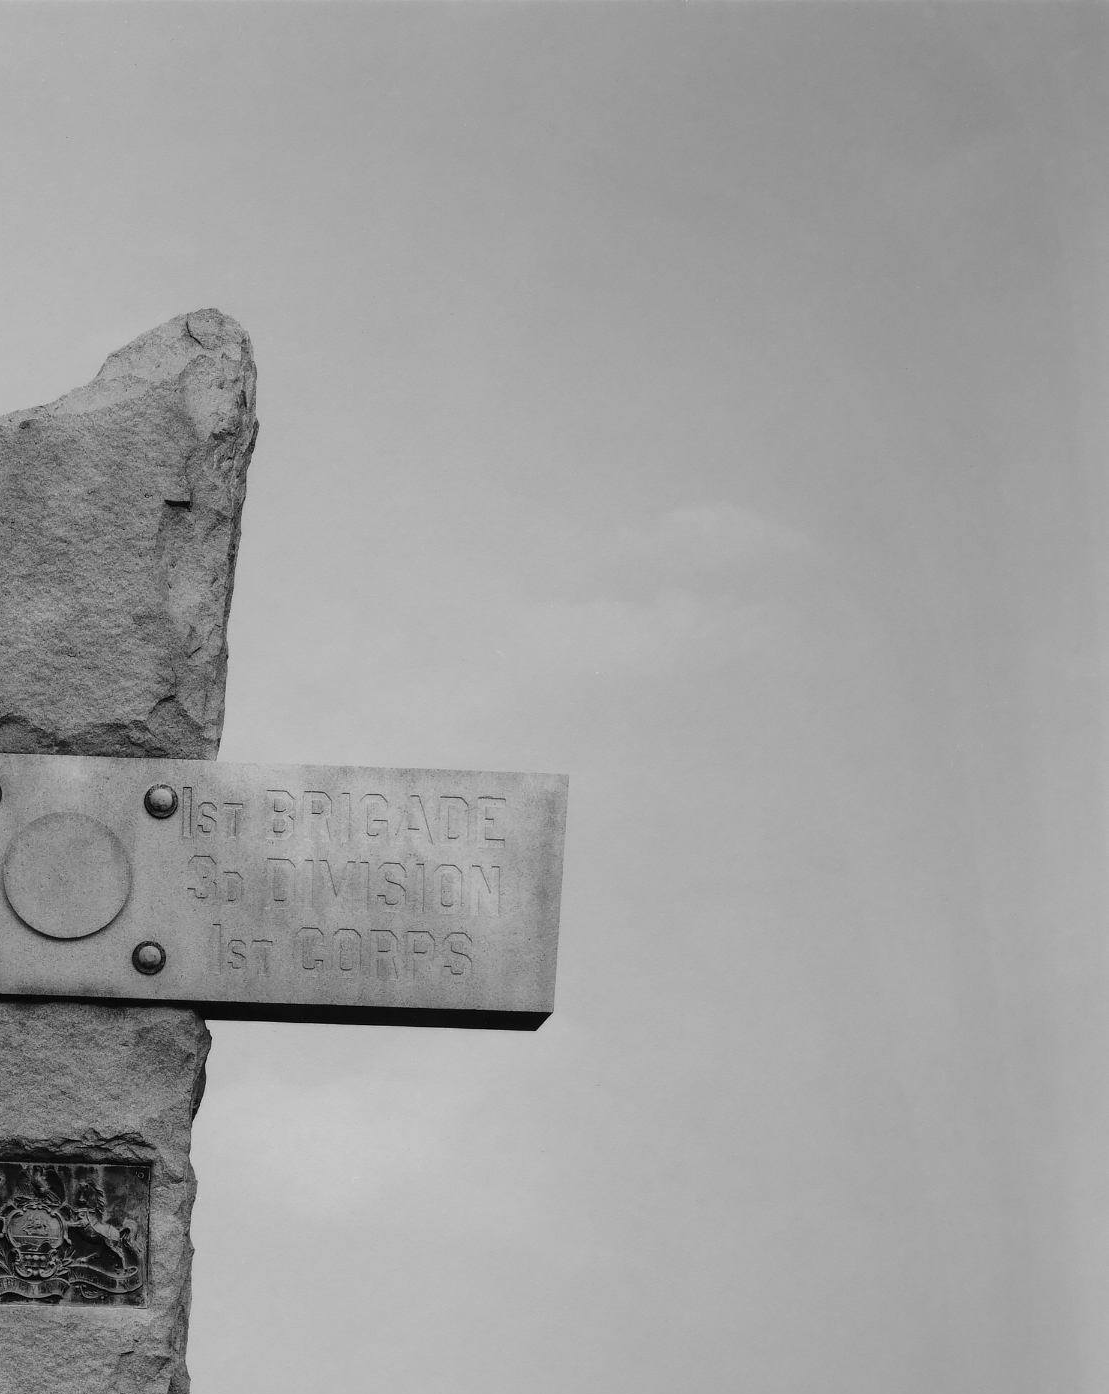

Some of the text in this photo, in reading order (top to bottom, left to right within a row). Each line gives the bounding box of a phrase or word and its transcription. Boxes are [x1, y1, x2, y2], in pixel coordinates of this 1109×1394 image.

[181, 786, 507, 848] 1ST BRIGADE
[187, 854, 502, 916] 3D DIVISION
[212, 922, 473, 982] 1ST CORPS
